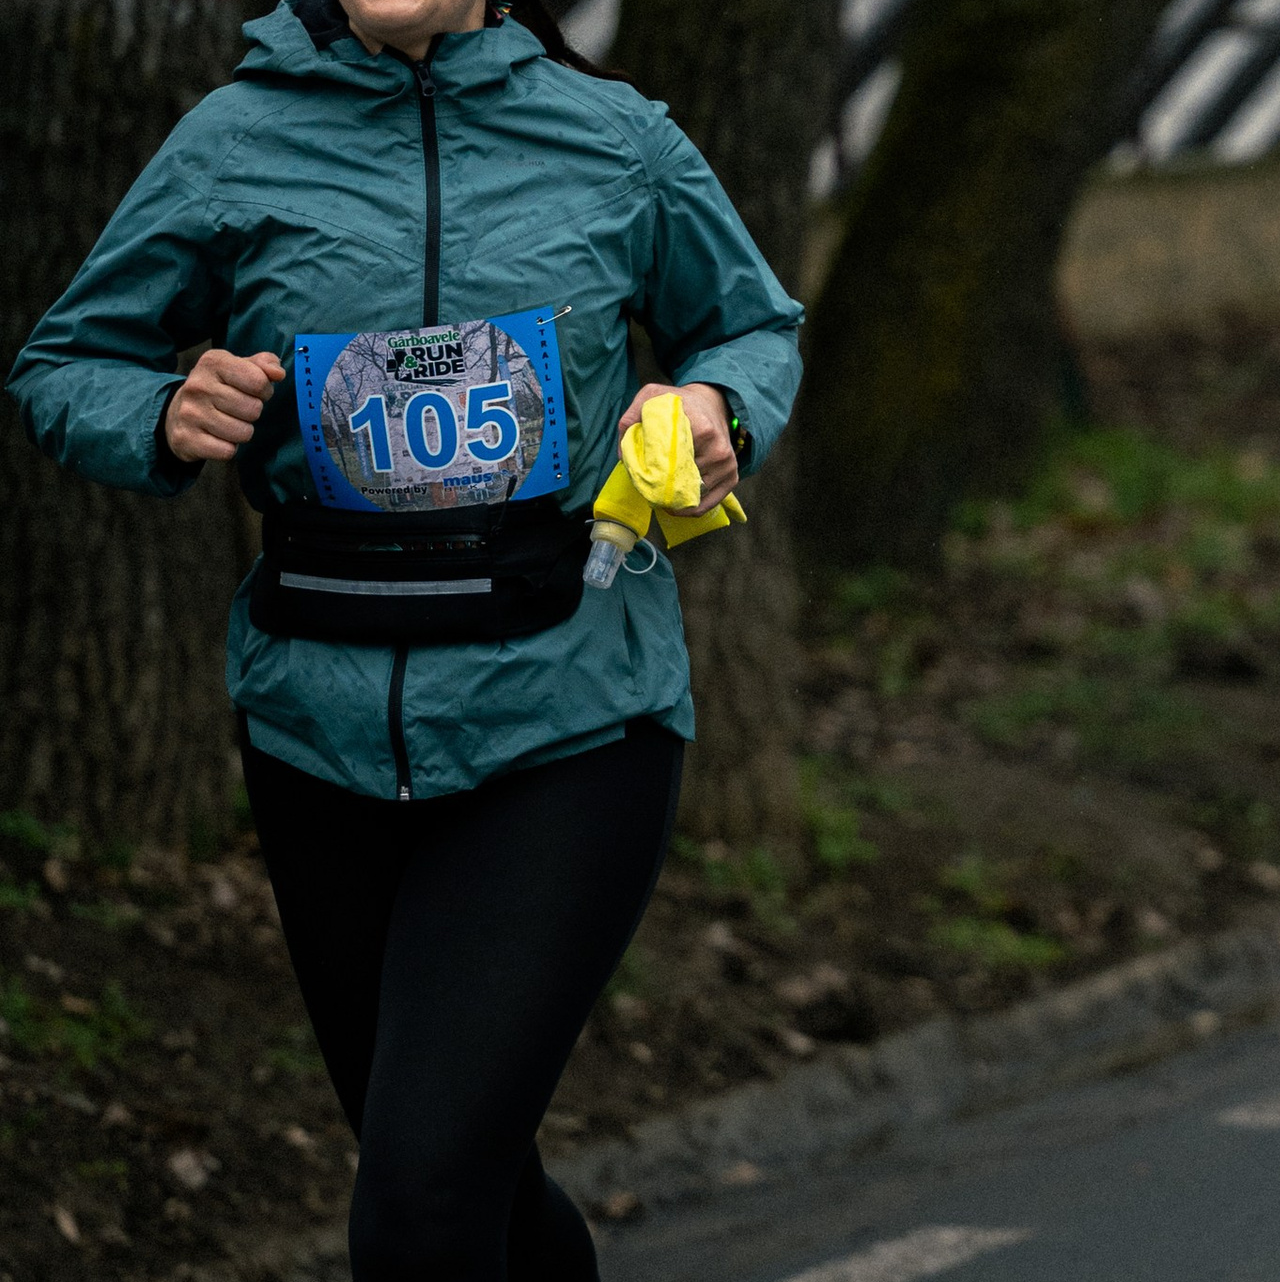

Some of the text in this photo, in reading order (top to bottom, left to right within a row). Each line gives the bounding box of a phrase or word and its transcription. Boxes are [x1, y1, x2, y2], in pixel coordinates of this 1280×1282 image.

[404, 355, 418, 369] &
[411, 342, 464, 362] RUN
[414, 358, 466, 378] RIDE
[538, 328, 551, 382] TRAIL
[547, 396, 556, 426] RUN
[304, 355, 315, 409] TRAIL
[311, 424, 322, 453] RUN
[349, 380, 520, 473] 105
[361, 485, 428, 495] Powered by
[443, 472, 493, 488] maus
